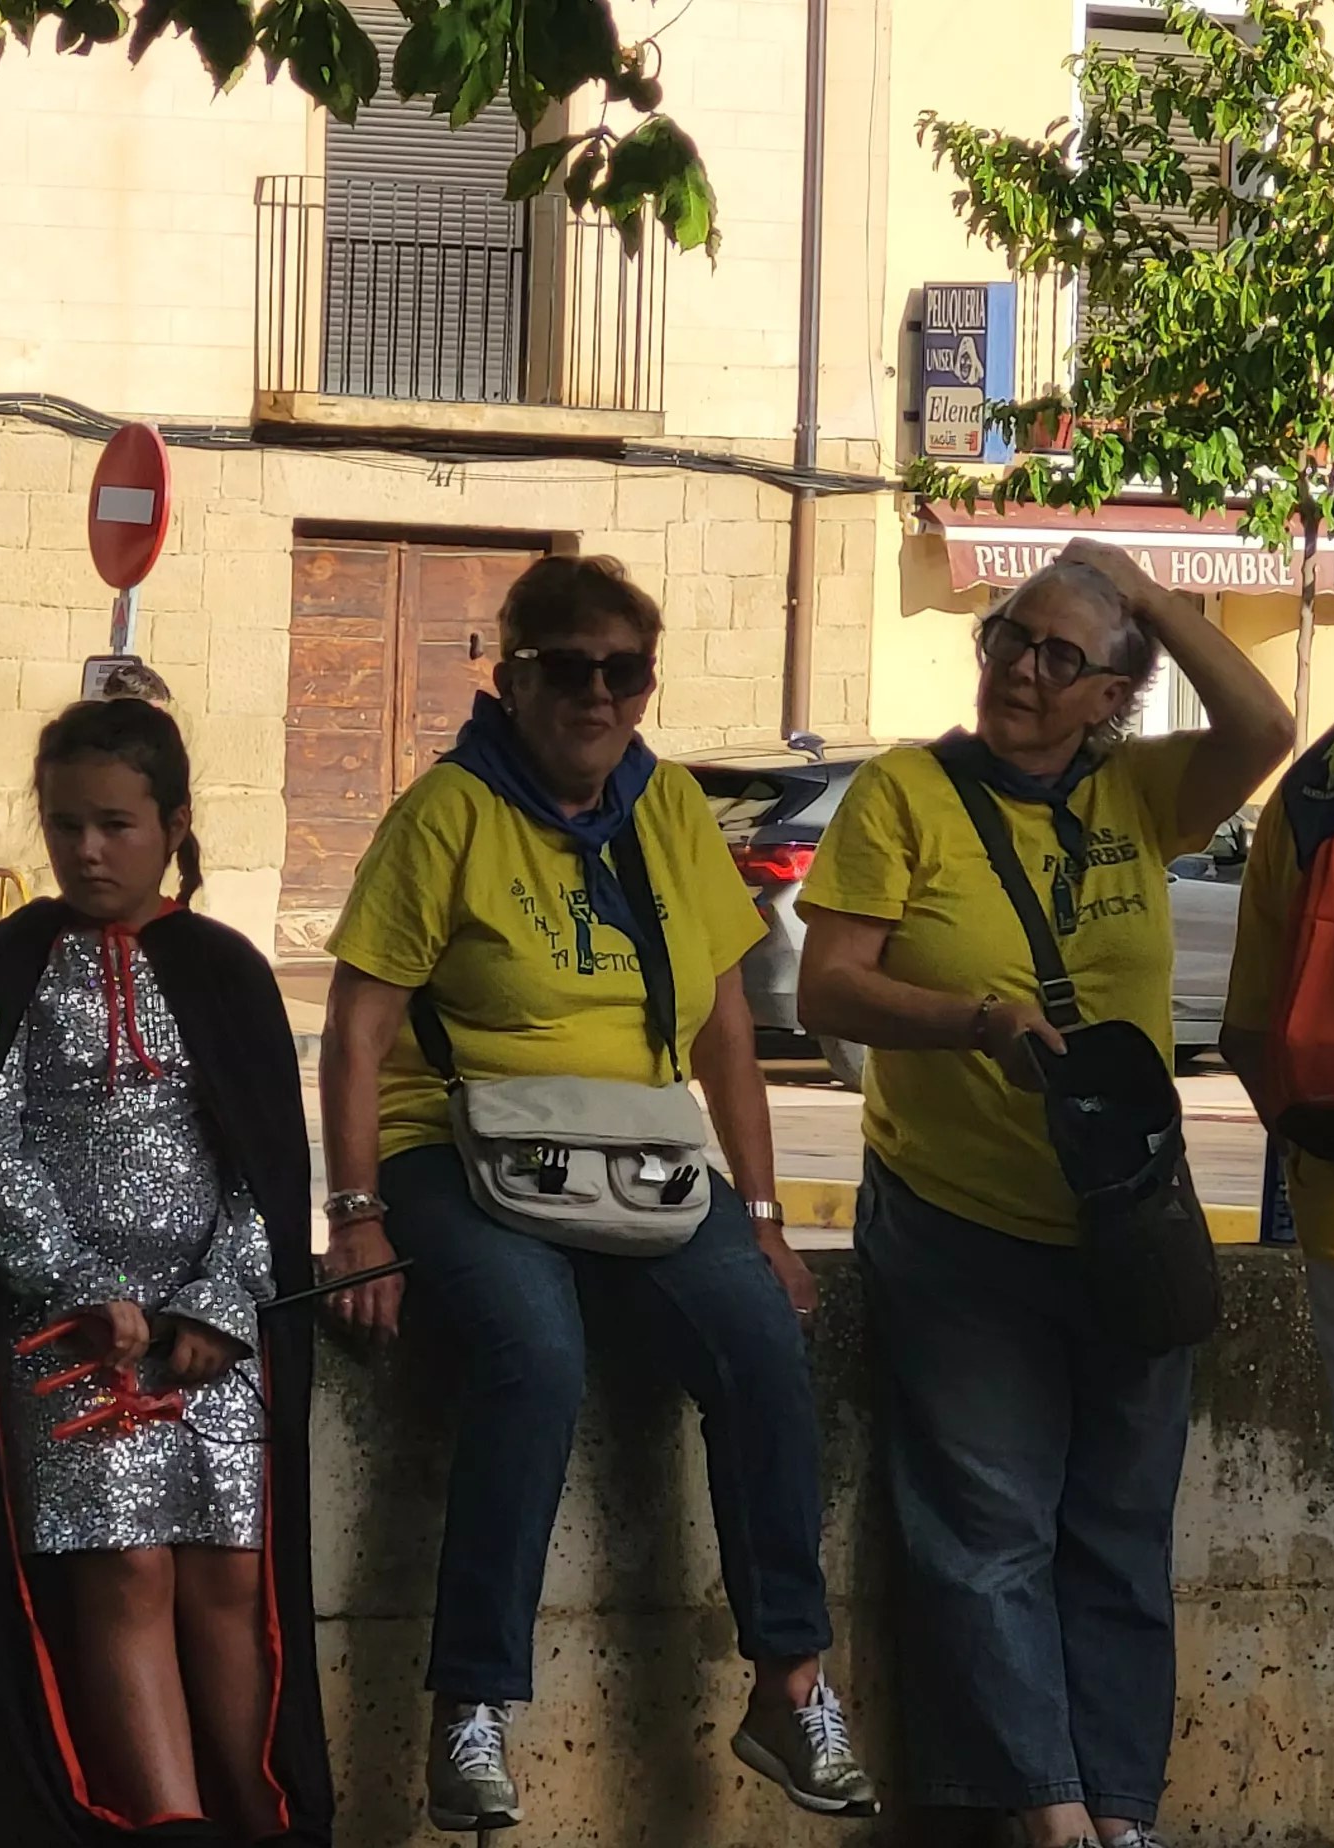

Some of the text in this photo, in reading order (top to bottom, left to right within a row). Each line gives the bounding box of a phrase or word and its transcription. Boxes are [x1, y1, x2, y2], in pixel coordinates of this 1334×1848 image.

[927, 289, 985, 337] PELUQUERIA
[927, 348, 955, 372] UNISEX
[928, 395, 981, 423] Elena
[1170, 551, 1294, 586] HOMBRE
